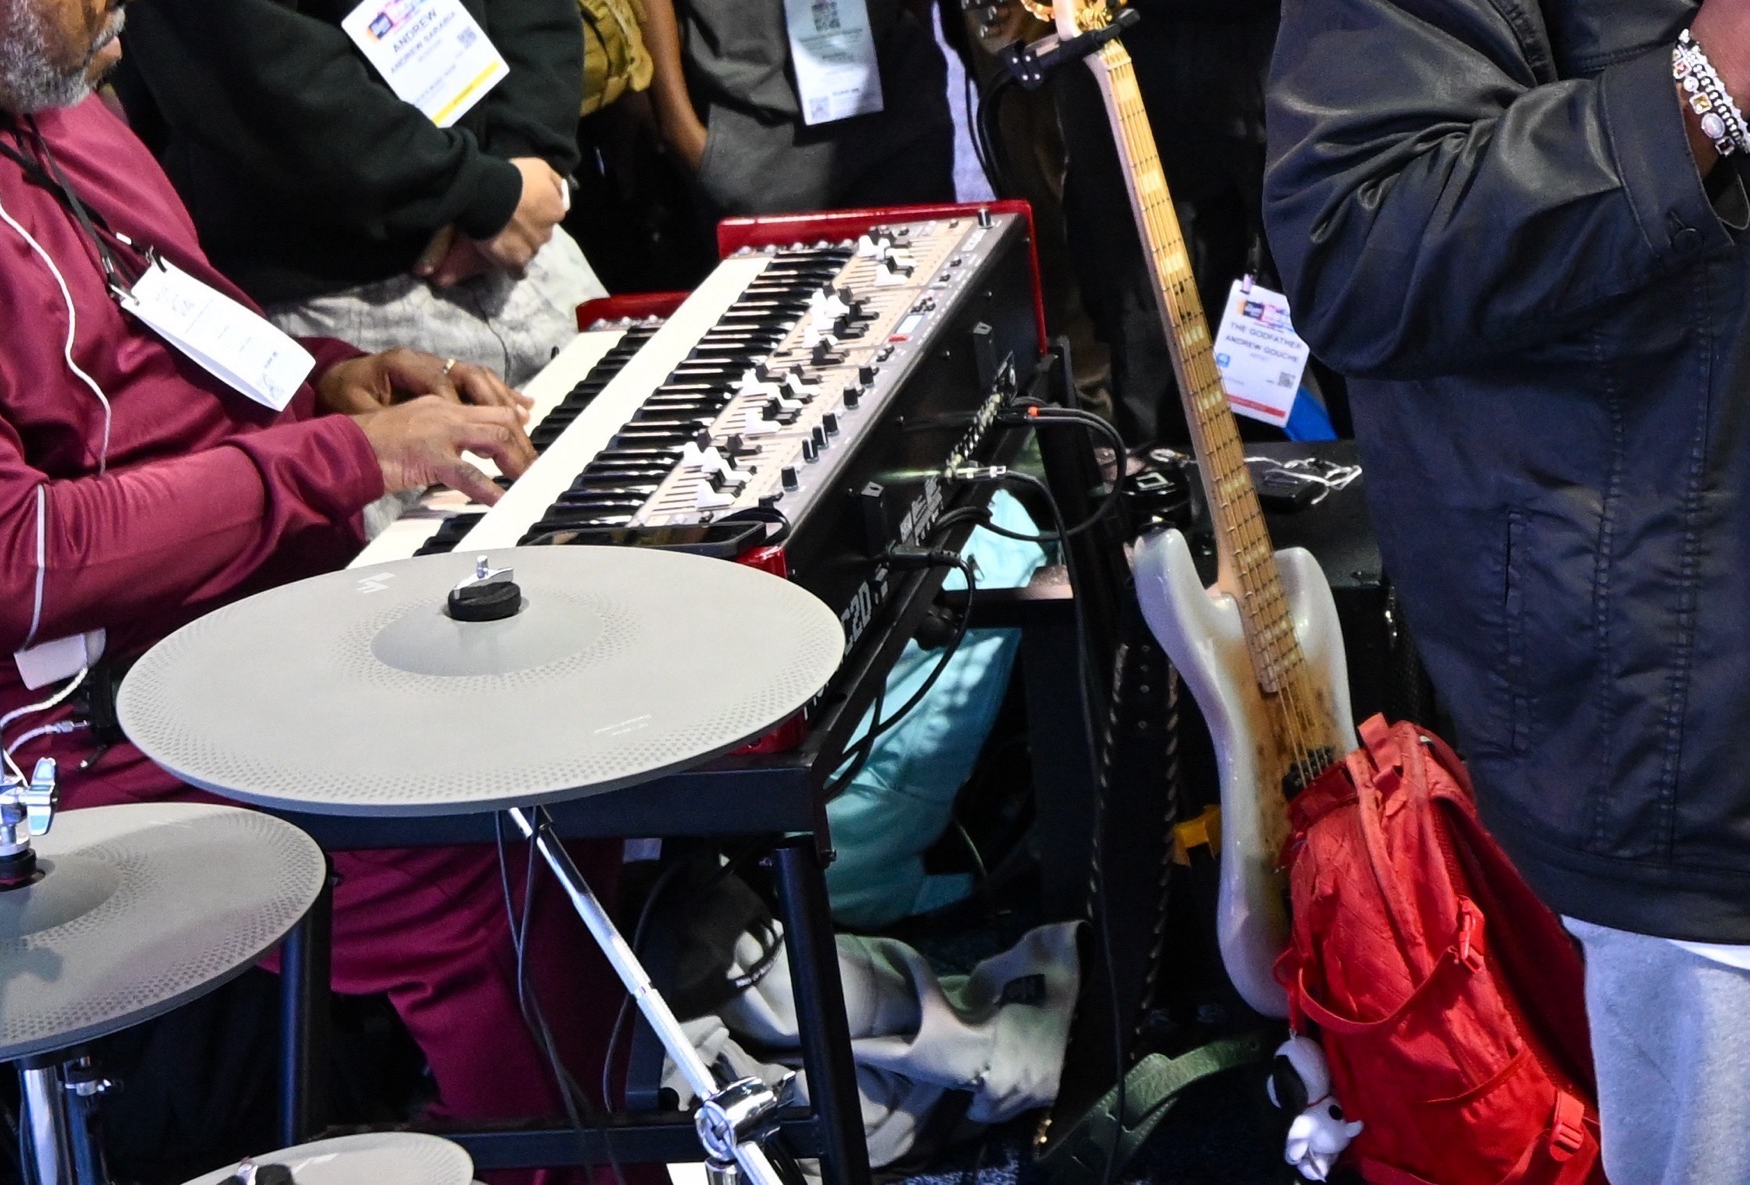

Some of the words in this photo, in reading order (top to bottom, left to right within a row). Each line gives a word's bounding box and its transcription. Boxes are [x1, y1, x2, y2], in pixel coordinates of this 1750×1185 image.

[392, 8, 438, 54] ANDREW
[1225, 334, 1262, 352] ANDREW
[1230, 321, 1247, 334] THE
[1249, 327, 1303, 350] GODFATHER
